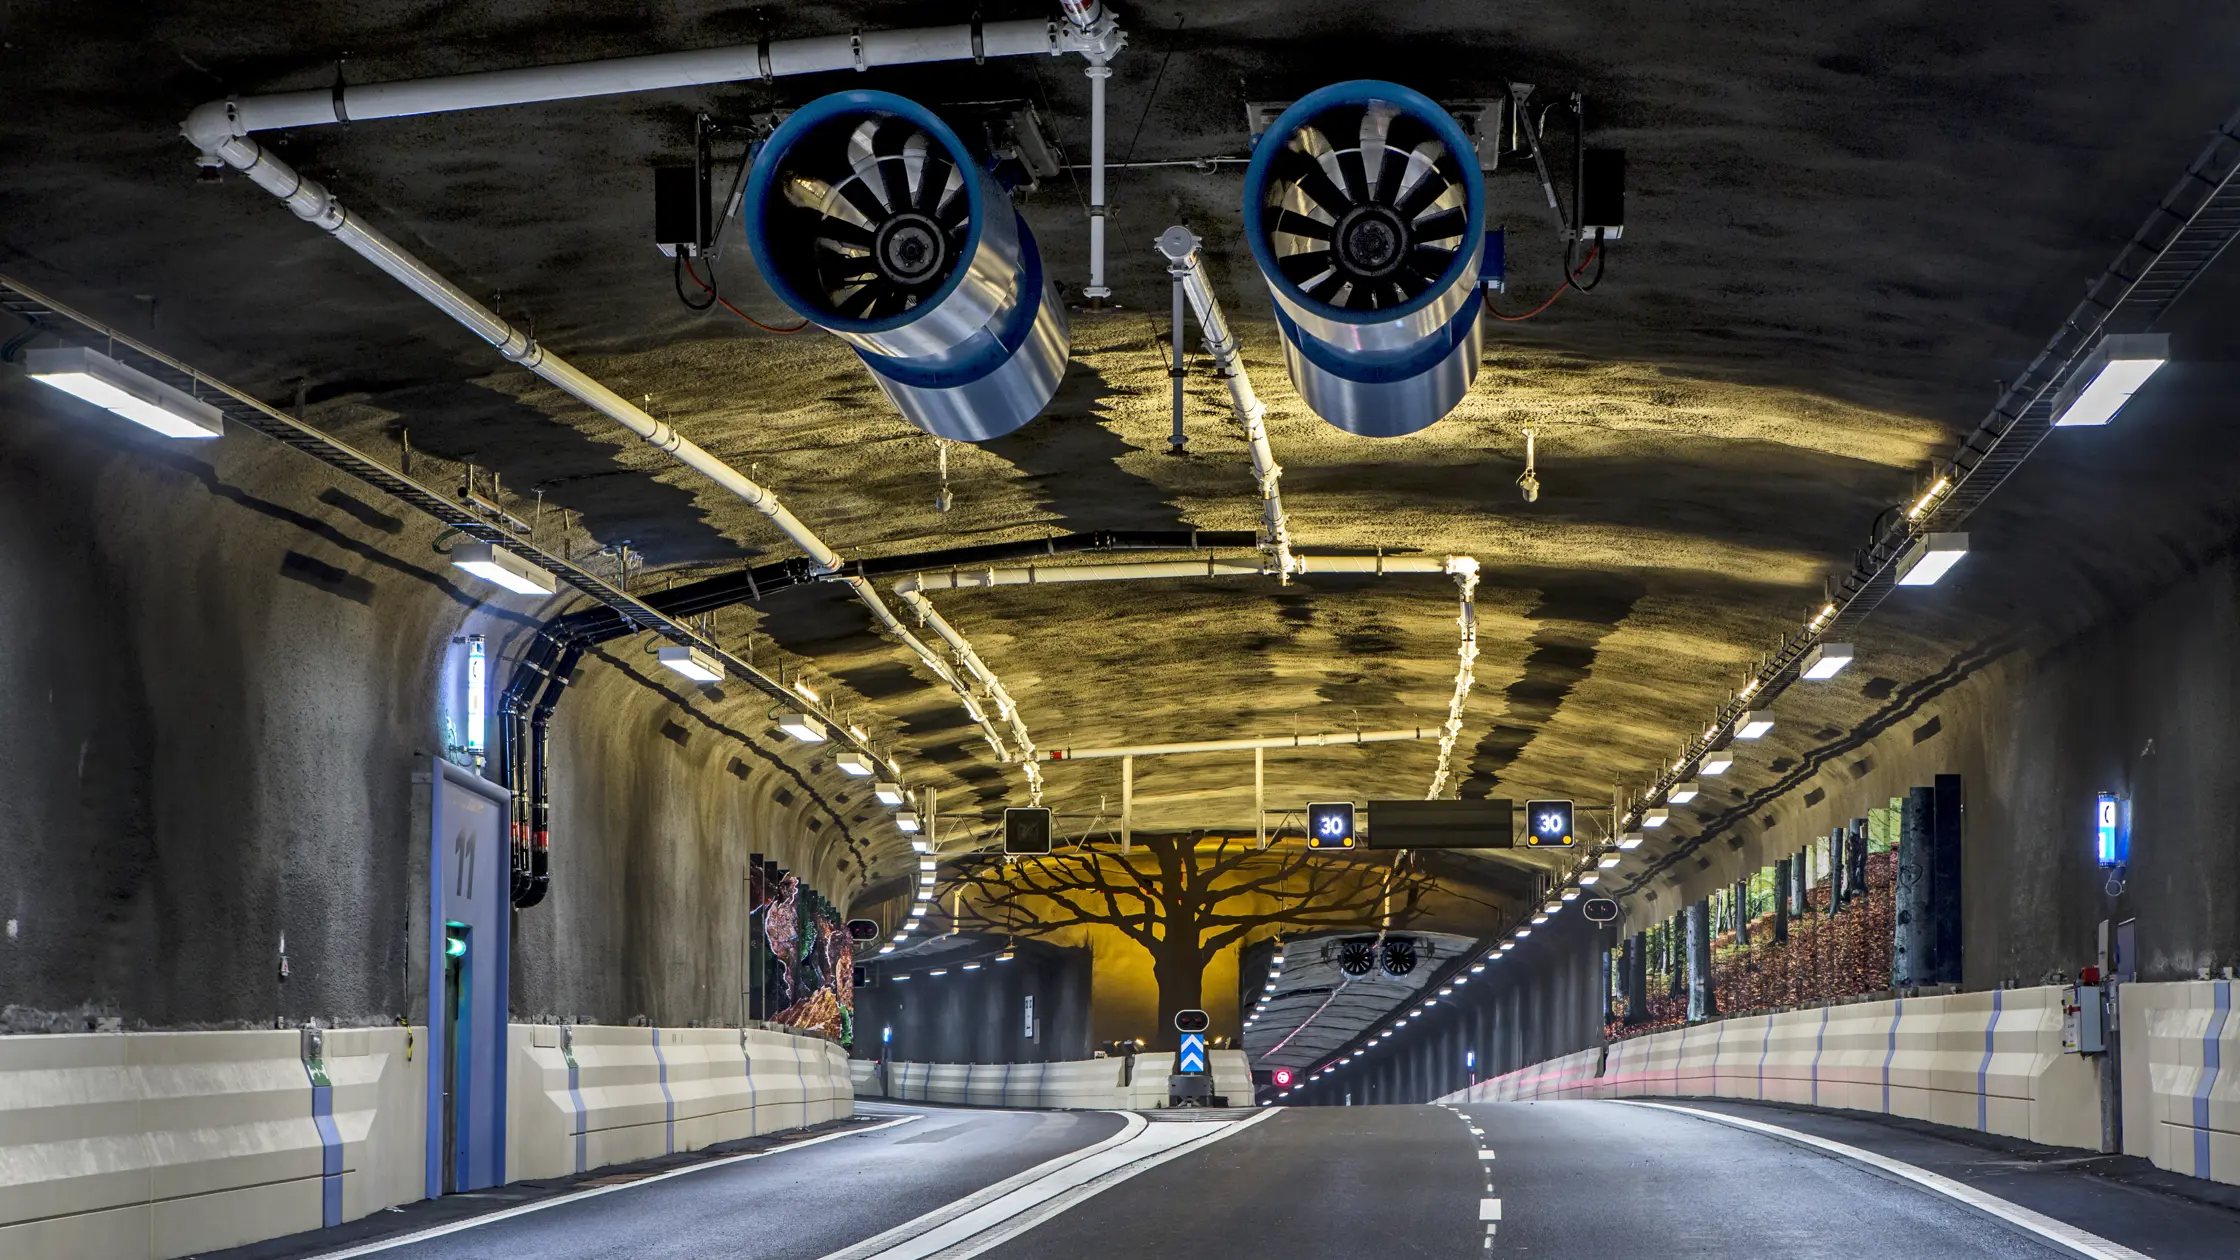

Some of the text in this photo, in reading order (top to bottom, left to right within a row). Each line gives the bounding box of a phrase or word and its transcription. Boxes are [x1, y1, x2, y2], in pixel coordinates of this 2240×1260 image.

[1321, 817, 1343, 834] 30
[1540, 814, 1562, 832] 30
[454, 821, 477, 900] 11
